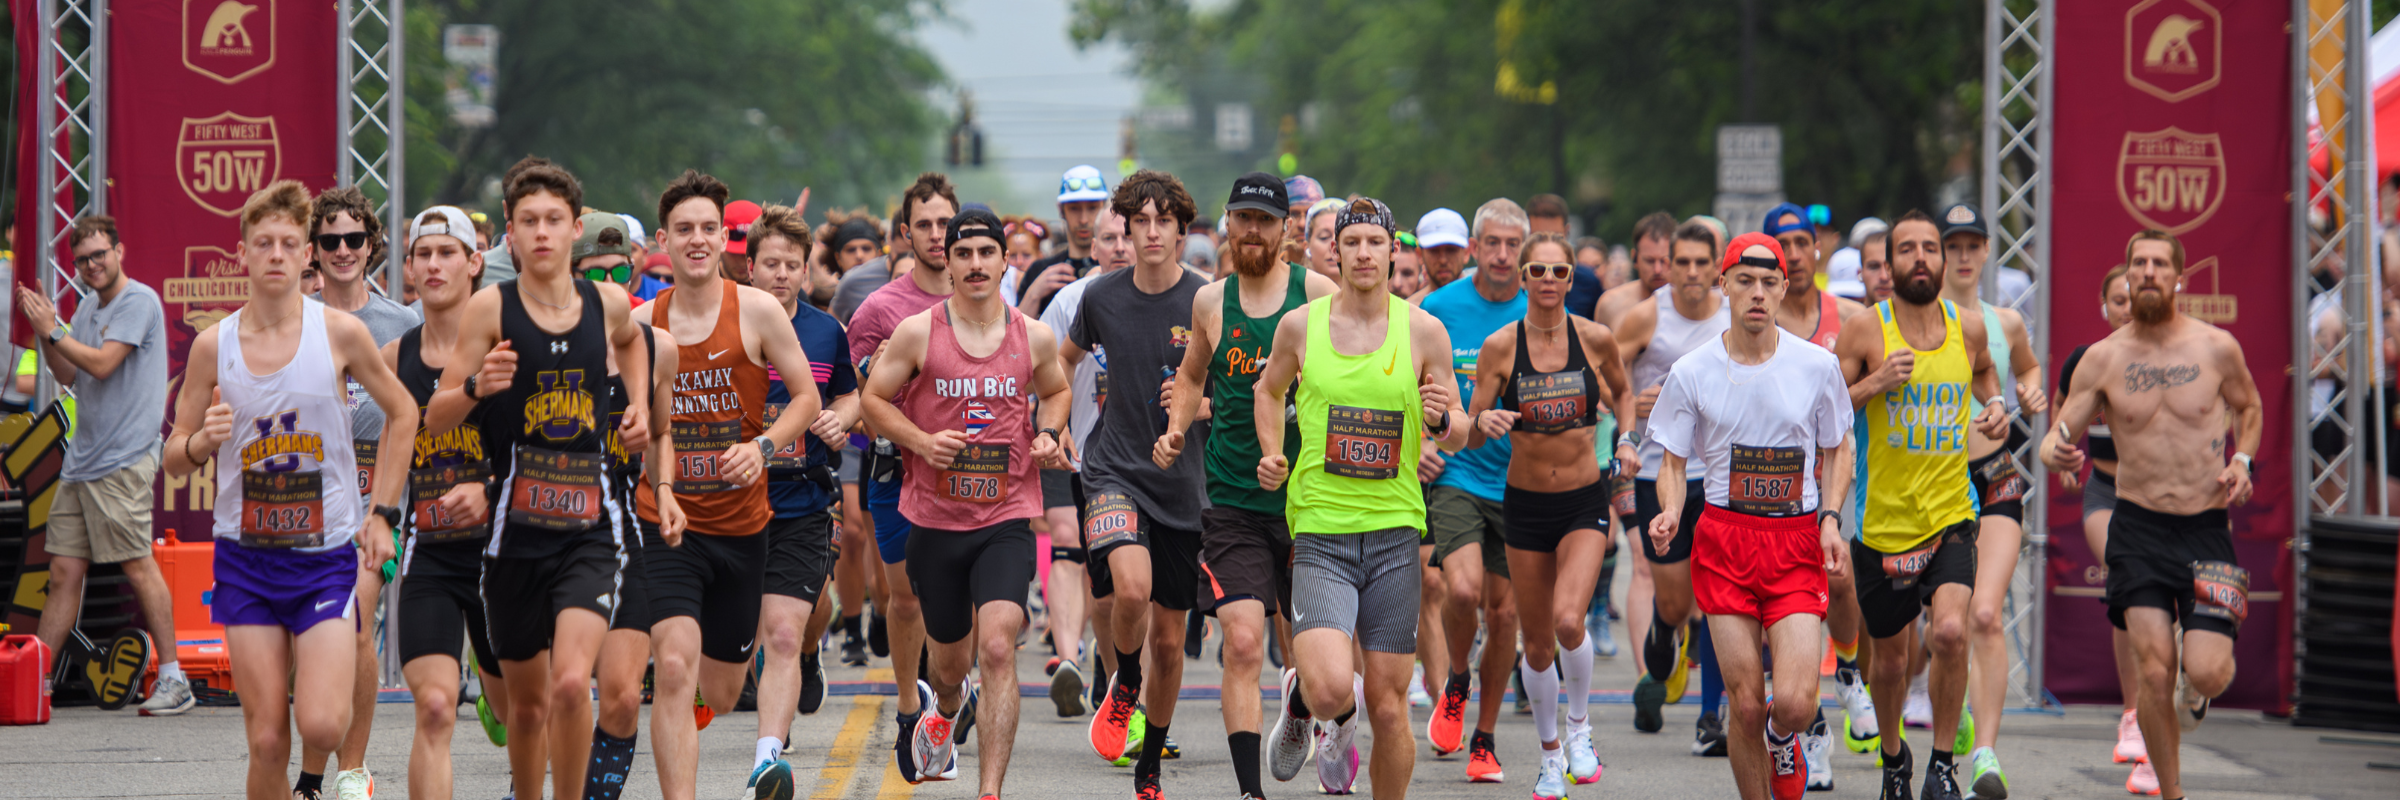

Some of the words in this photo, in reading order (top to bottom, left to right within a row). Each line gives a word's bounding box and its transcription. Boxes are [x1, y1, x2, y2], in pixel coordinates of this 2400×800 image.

[194, 125, 226, 139] FIFTY
[229, 124, 262, 139] WEST
[193, 150, 266, 193] 50W
[2134, 166, 2211, 212] 50W
[168, 281, 249, 298] CHILLICOTHE
[672, 367, 732, 392] CKAWAY
[935, 378, 977, 397] RUN
[670, 393, 719, 415] UNNING
[1542, 387, 1581, 398] MARATHON
[1886, 382, 1967, 408] ENJOY
[524, 390, 597, 435] SHERMANS
[1530, 399, 1577, 421] 1343
[1886, 401, 1959, 428] YOUR
[1333, 424, 1354, 433] HALF
[1355, 427, 1398, 437] MARATHON
[1907, 425, 1963, 451] LIFE
[241, 432, 325, 471] SHERMANS
[674, 442, 692, 450] HALF
[694, 439, 737, 449] MARATHON
[1338, 438, 1391, 465] 1594
[524, 467, 546, 479] HALF
[548, 472, 594, 484] MARATHON
[679, 454, 726, 478] 151
[964, 463, 1004, 471] MARATHON
[1736, 463, 1756, 471] HALF
[1758, 464, 1800, 473] MARATHON
[248, 490, 267, 499] HALF
[269, 491, 316, 501] MARATHON
[419, 489, 438, 499] HALF
[947, 474, 999, 499] 1578
[1741, 476, 1793, 499] 1587
[528, 484, 586, 514] 1340
[1093, 503, 1132, 516] MARATHON
[253, 506, 311, 532] 1432
[1086, 513, 1128, 542] 1406
